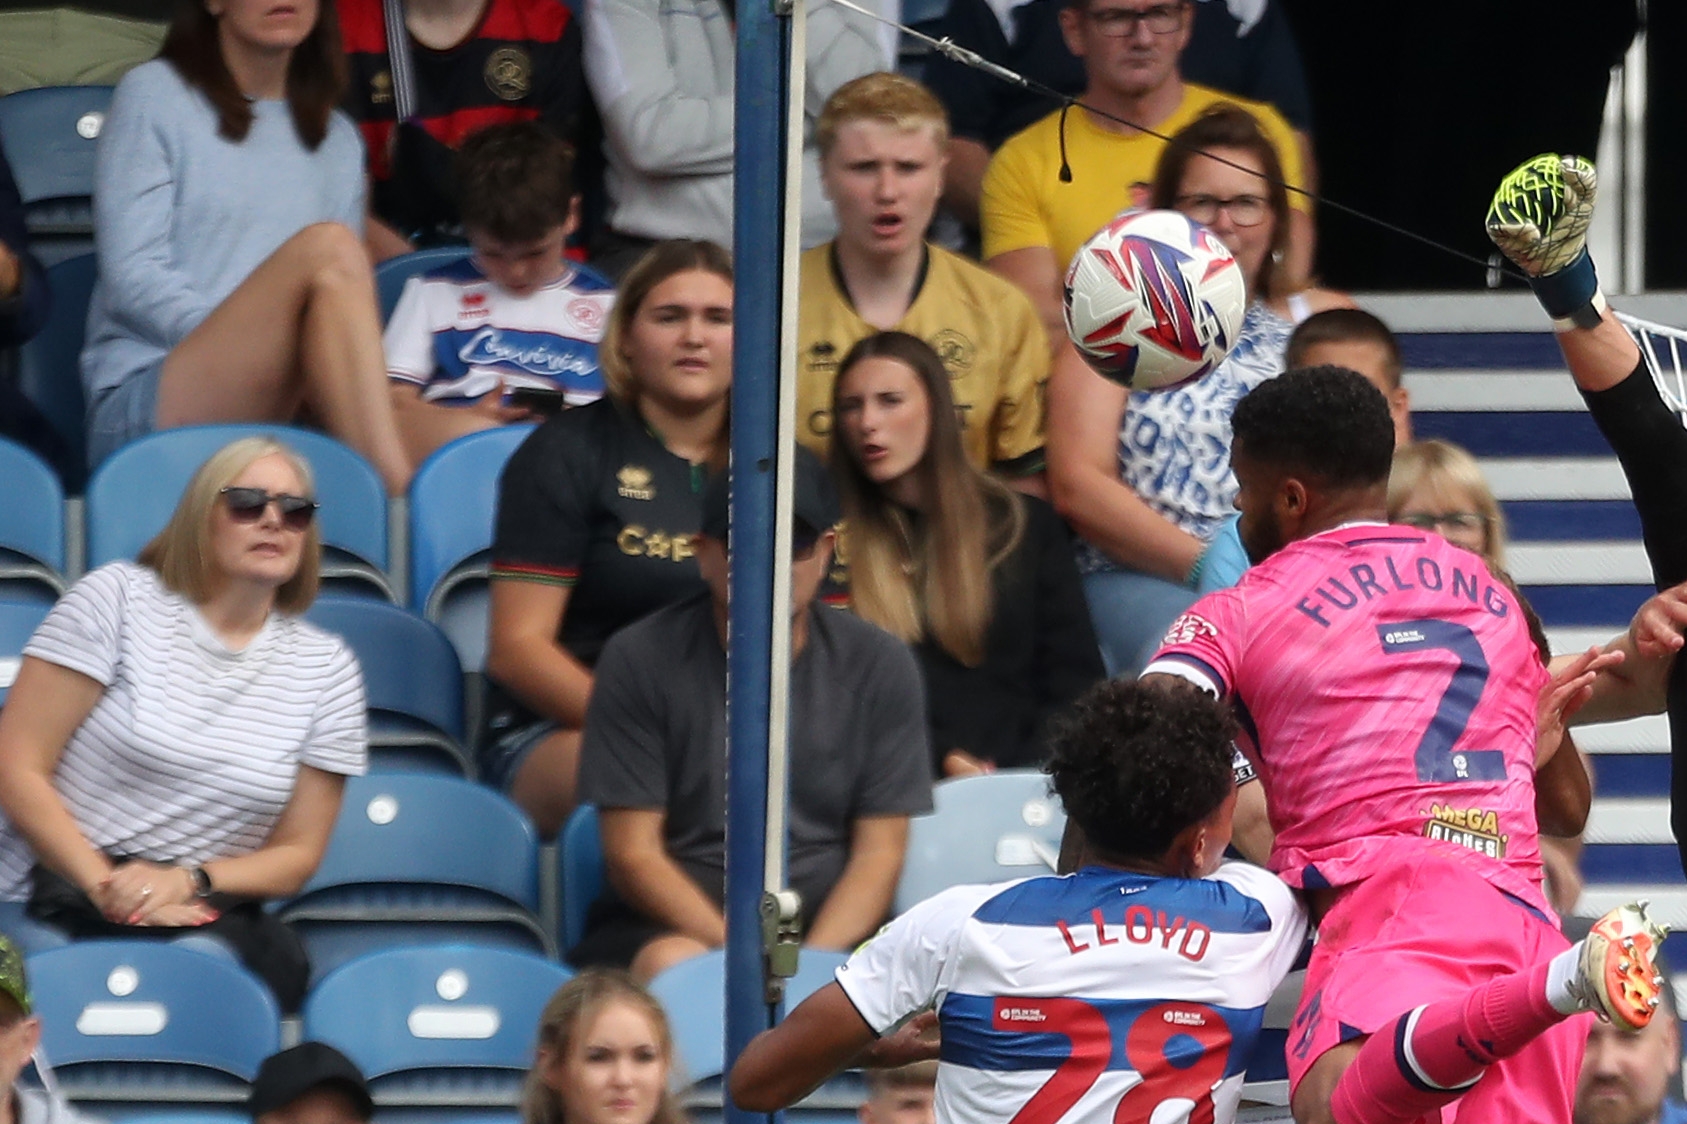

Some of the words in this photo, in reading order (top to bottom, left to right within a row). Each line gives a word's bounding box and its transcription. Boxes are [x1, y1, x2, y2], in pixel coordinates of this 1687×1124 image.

[1295, 556, 1508, 629] FURLONG
[1375, 618, 1509, 782] 2
[1431, 803, 1499, 836] MEGA
[1055, 904, 1212, 963] LLOYD
